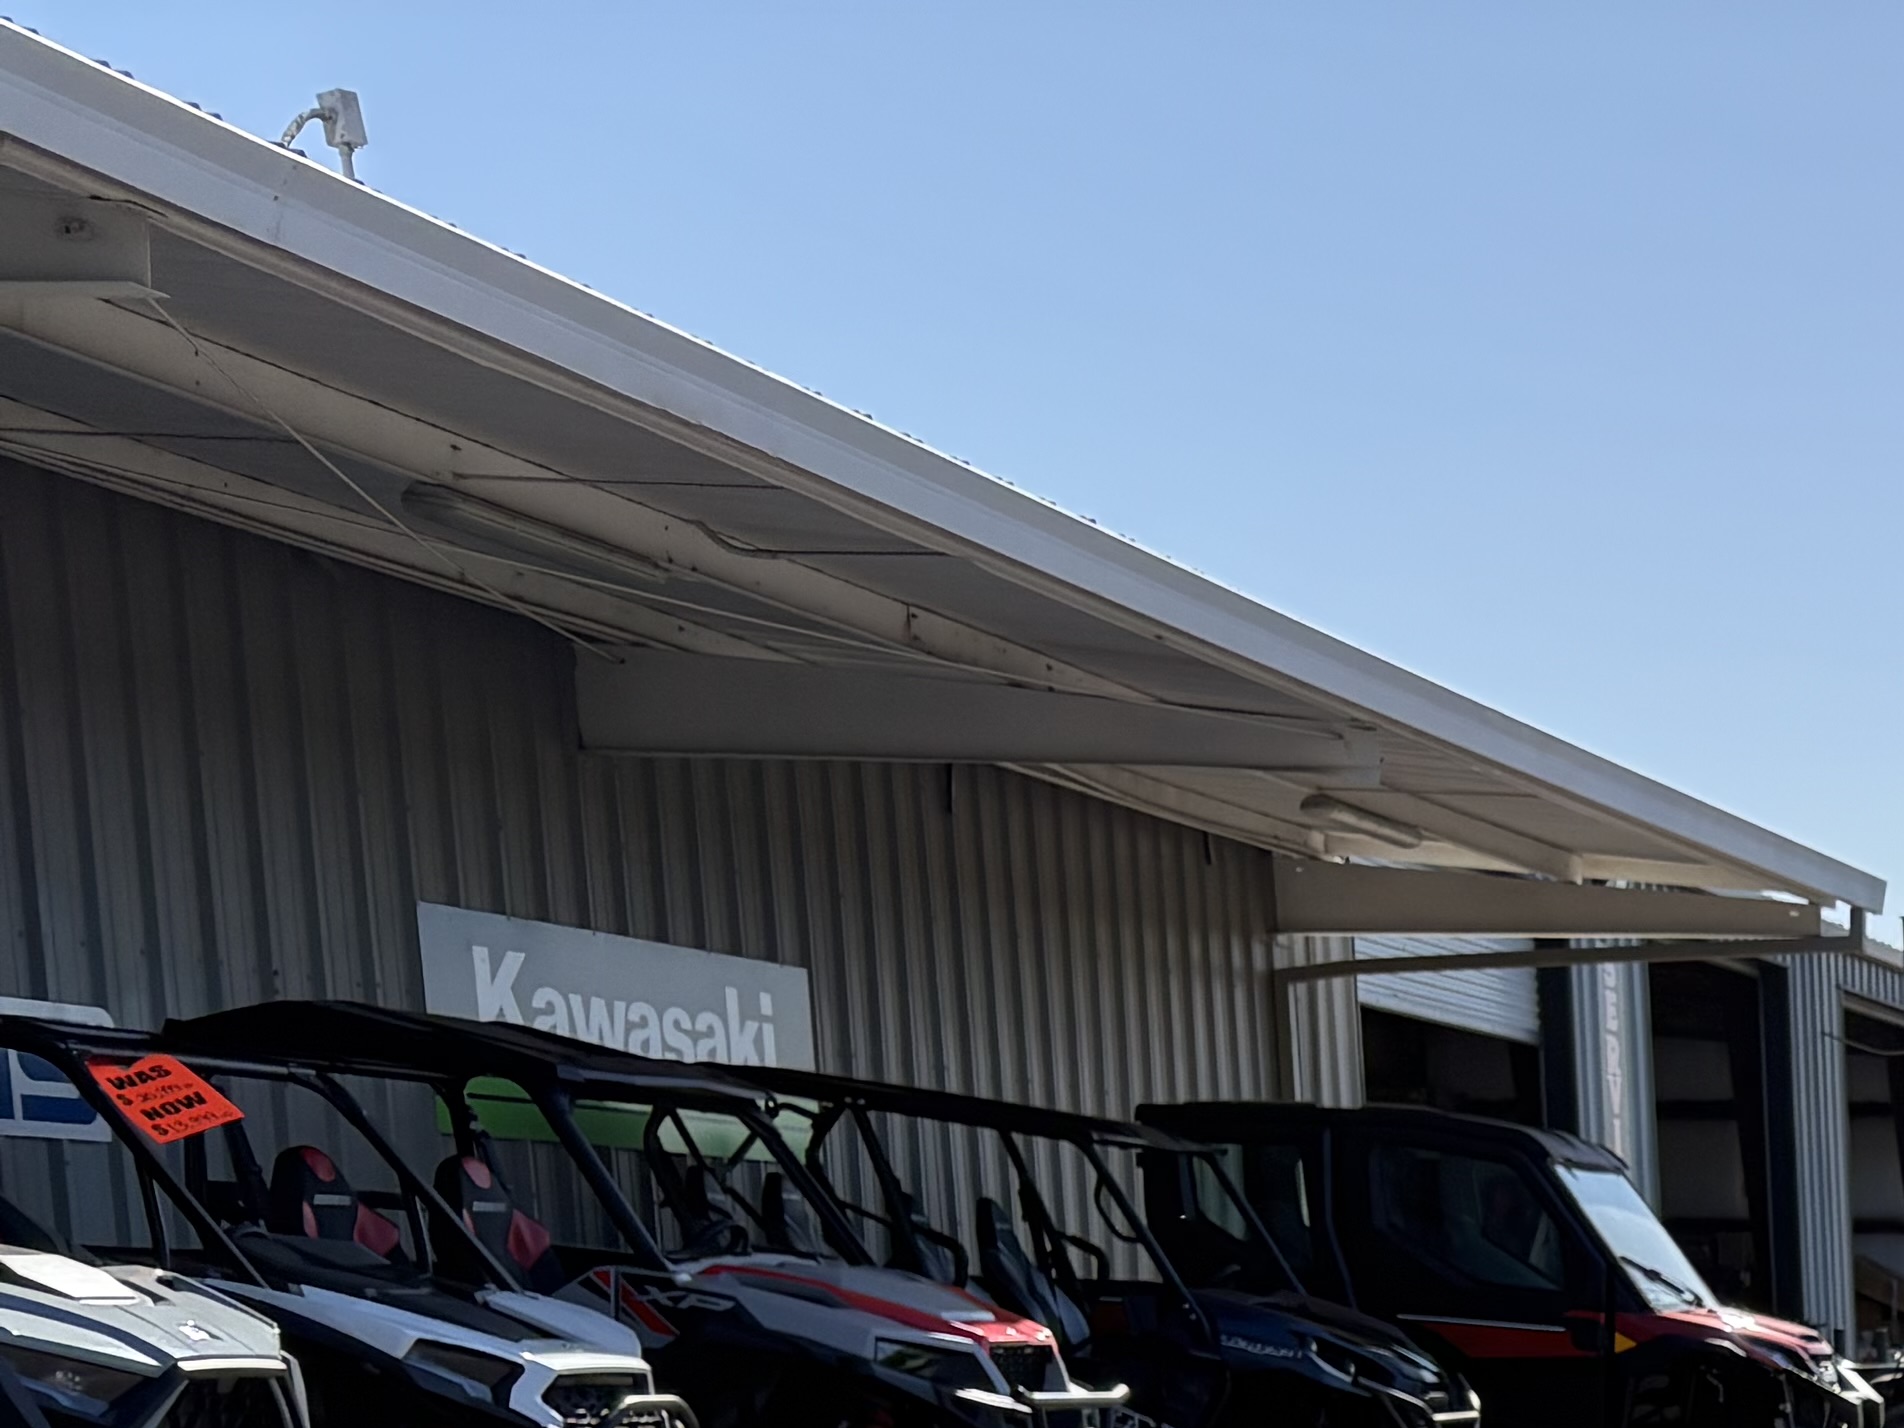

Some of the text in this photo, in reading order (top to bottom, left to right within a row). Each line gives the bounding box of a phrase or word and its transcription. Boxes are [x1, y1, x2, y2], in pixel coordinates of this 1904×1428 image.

[472, 945, 778, 1068] Kawasaki
[106, 1065, 173, 1091] WAS
[140, 1091, 207, 1121] NOW
[641, 1285, 736, 1312] XP
